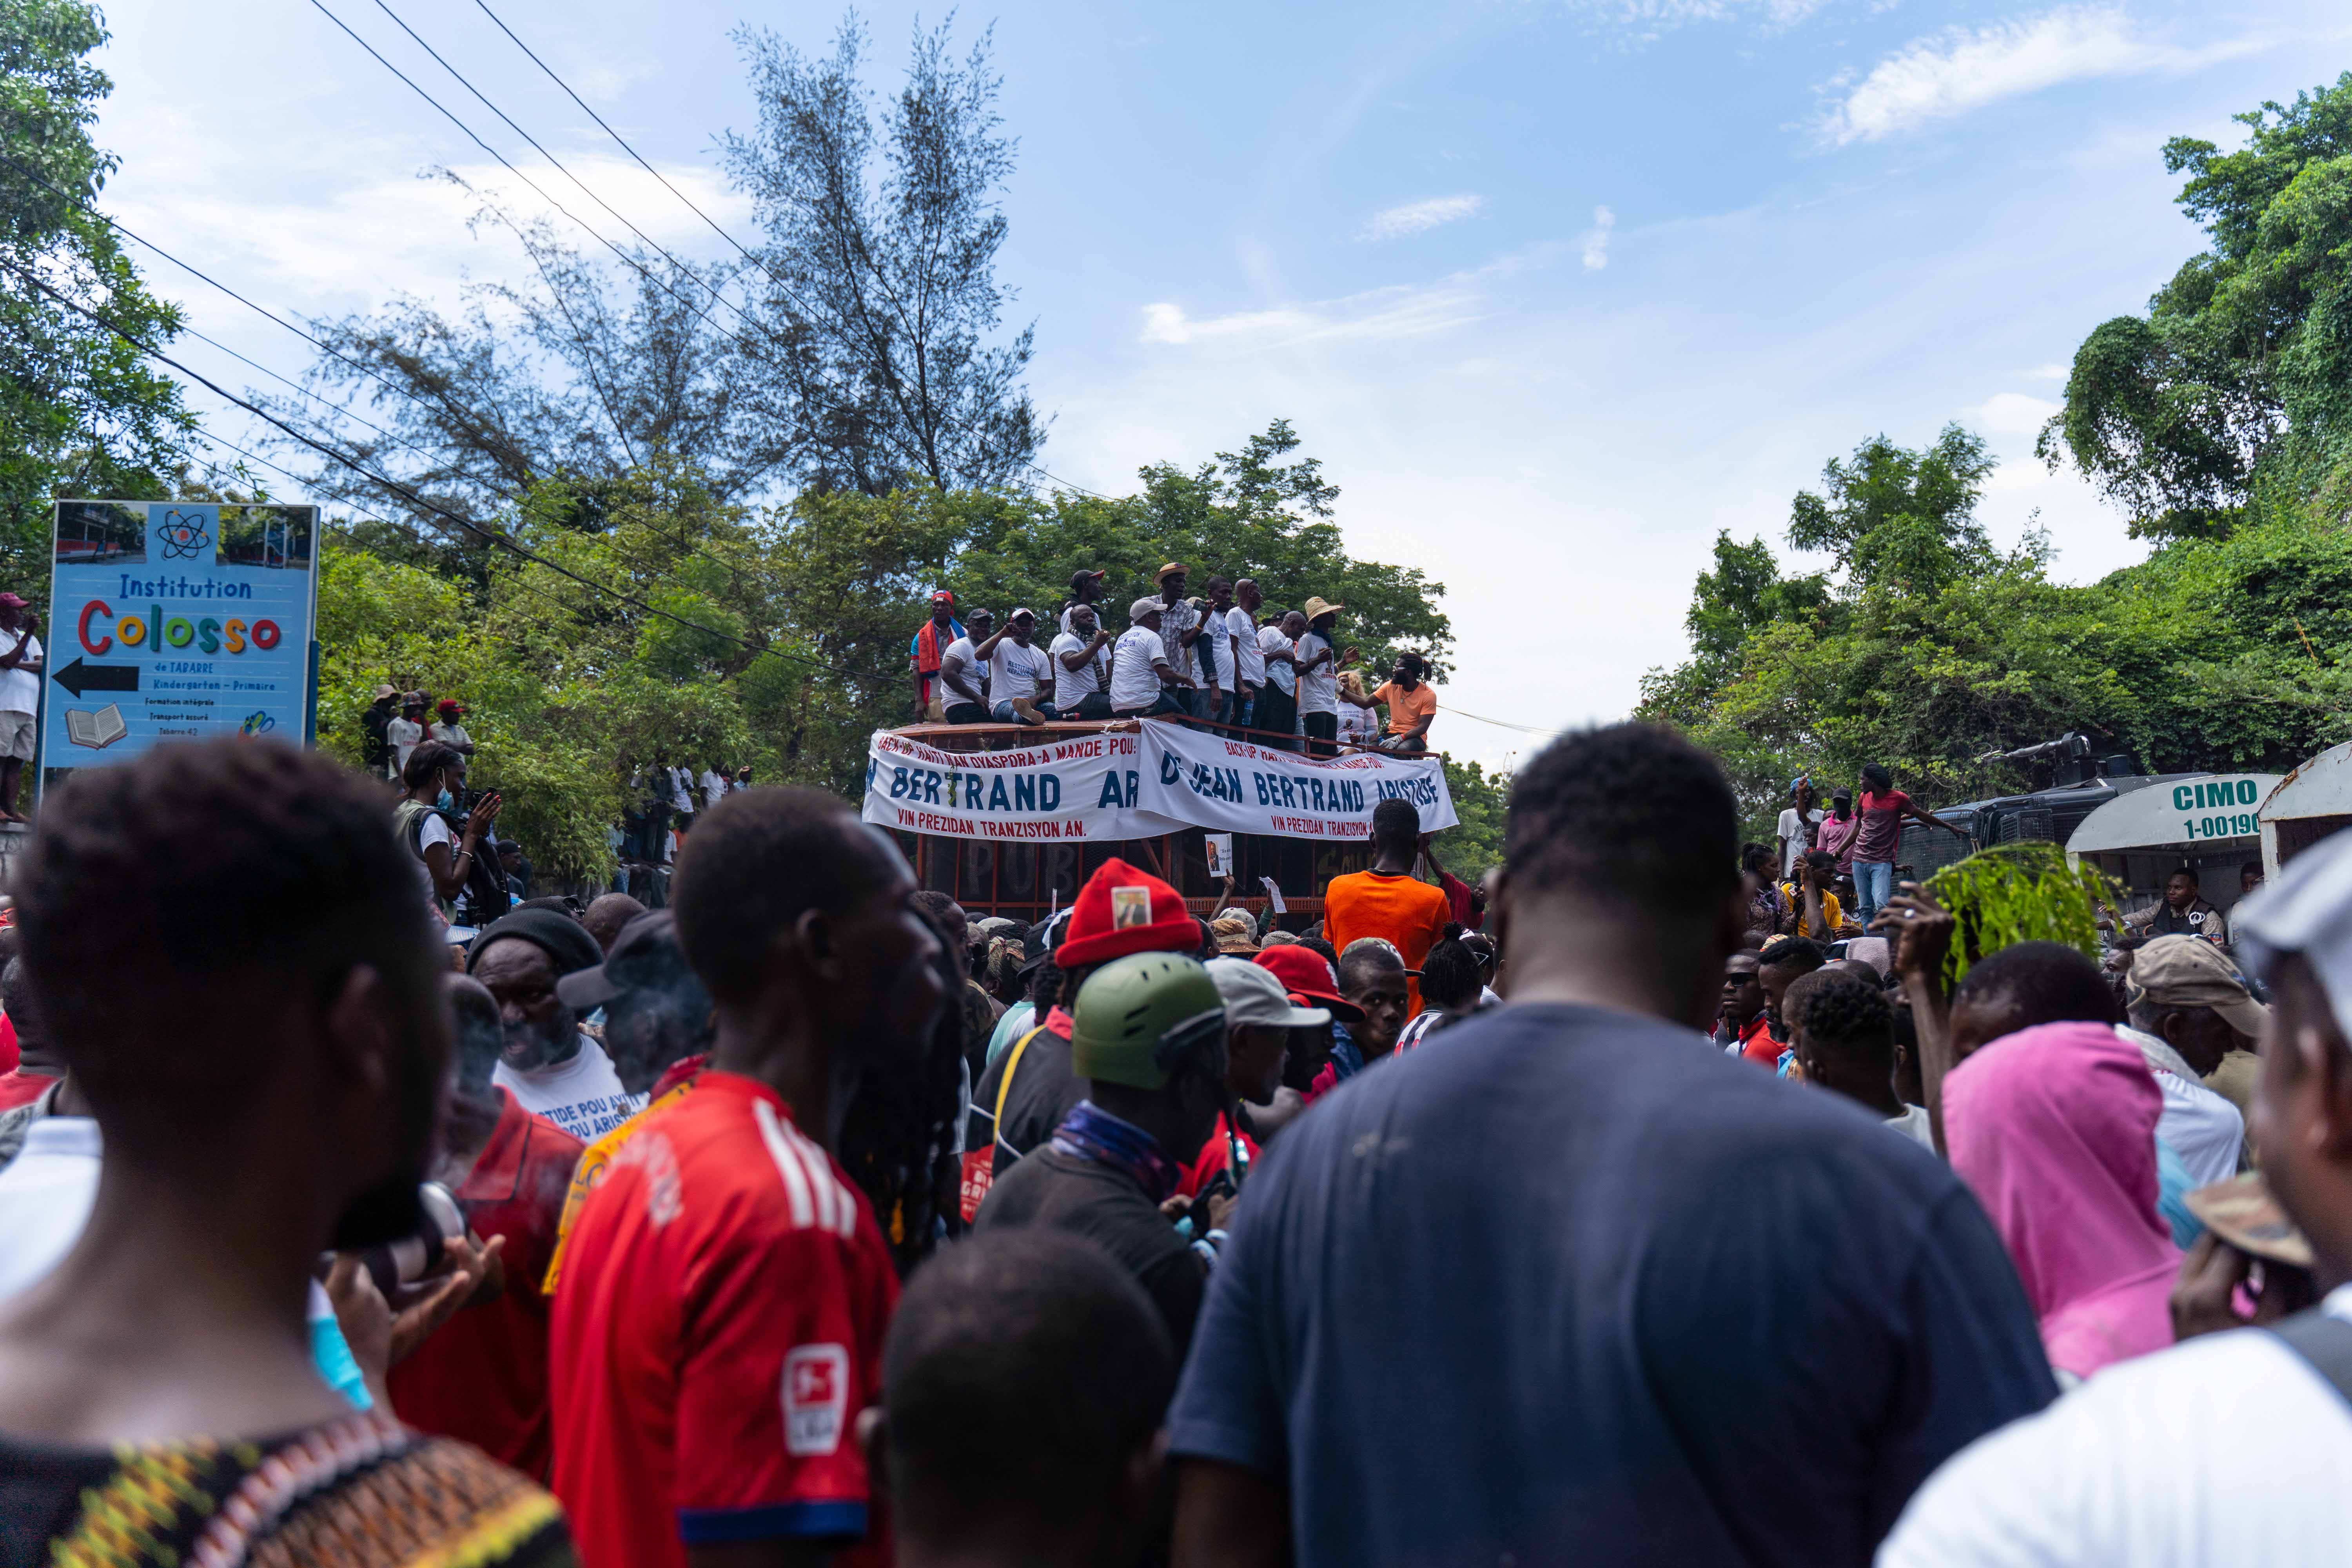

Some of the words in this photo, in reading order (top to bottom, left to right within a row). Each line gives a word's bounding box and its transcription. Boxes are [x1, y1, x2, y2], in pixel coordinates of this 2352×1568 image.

[120, 574, 251, 599] Institution
[78, 600, 280, 655] Colosso
[155, 662, 167, 671] de
[170, 662, 213, 674] TABARRE
[154, 679, 220, 690] Kindergarten
[233, 681, 275, 691] Primaire
[150, 712, 184, 721] Transport
[878, 736, 915, 755] BACK-UP
[916, 746, 944, 764] HAITI
[944, 753, 970, 768] NAN
[1055, 740, 1102, 761] MANDE
[1109, 737, 1136, 755] POU:
[1225, 741, 1256, 759] BACK-UP
[890, 767, 1060, 811] BERTRAND
[1189, 762, 1243, 803] JEAN
[1253, 771, 1364, 812] BERTRAND
[2173, 780, 2257, 810] CIMO
[898, 808, 915, 826] VIN
[918, 812, 975, 835] PREZIDAN
[980, 821, 1060, 837] TRANZISYON
[1065, 820, 1087, 837] AN.
[1271, 815, 1286, 831] VIN
[1287, 817, 1324, 835] PREZIDAN
[1327, 821, 1368, 836] TRANZISYON
[577, 1098, 608, 1117] POU
